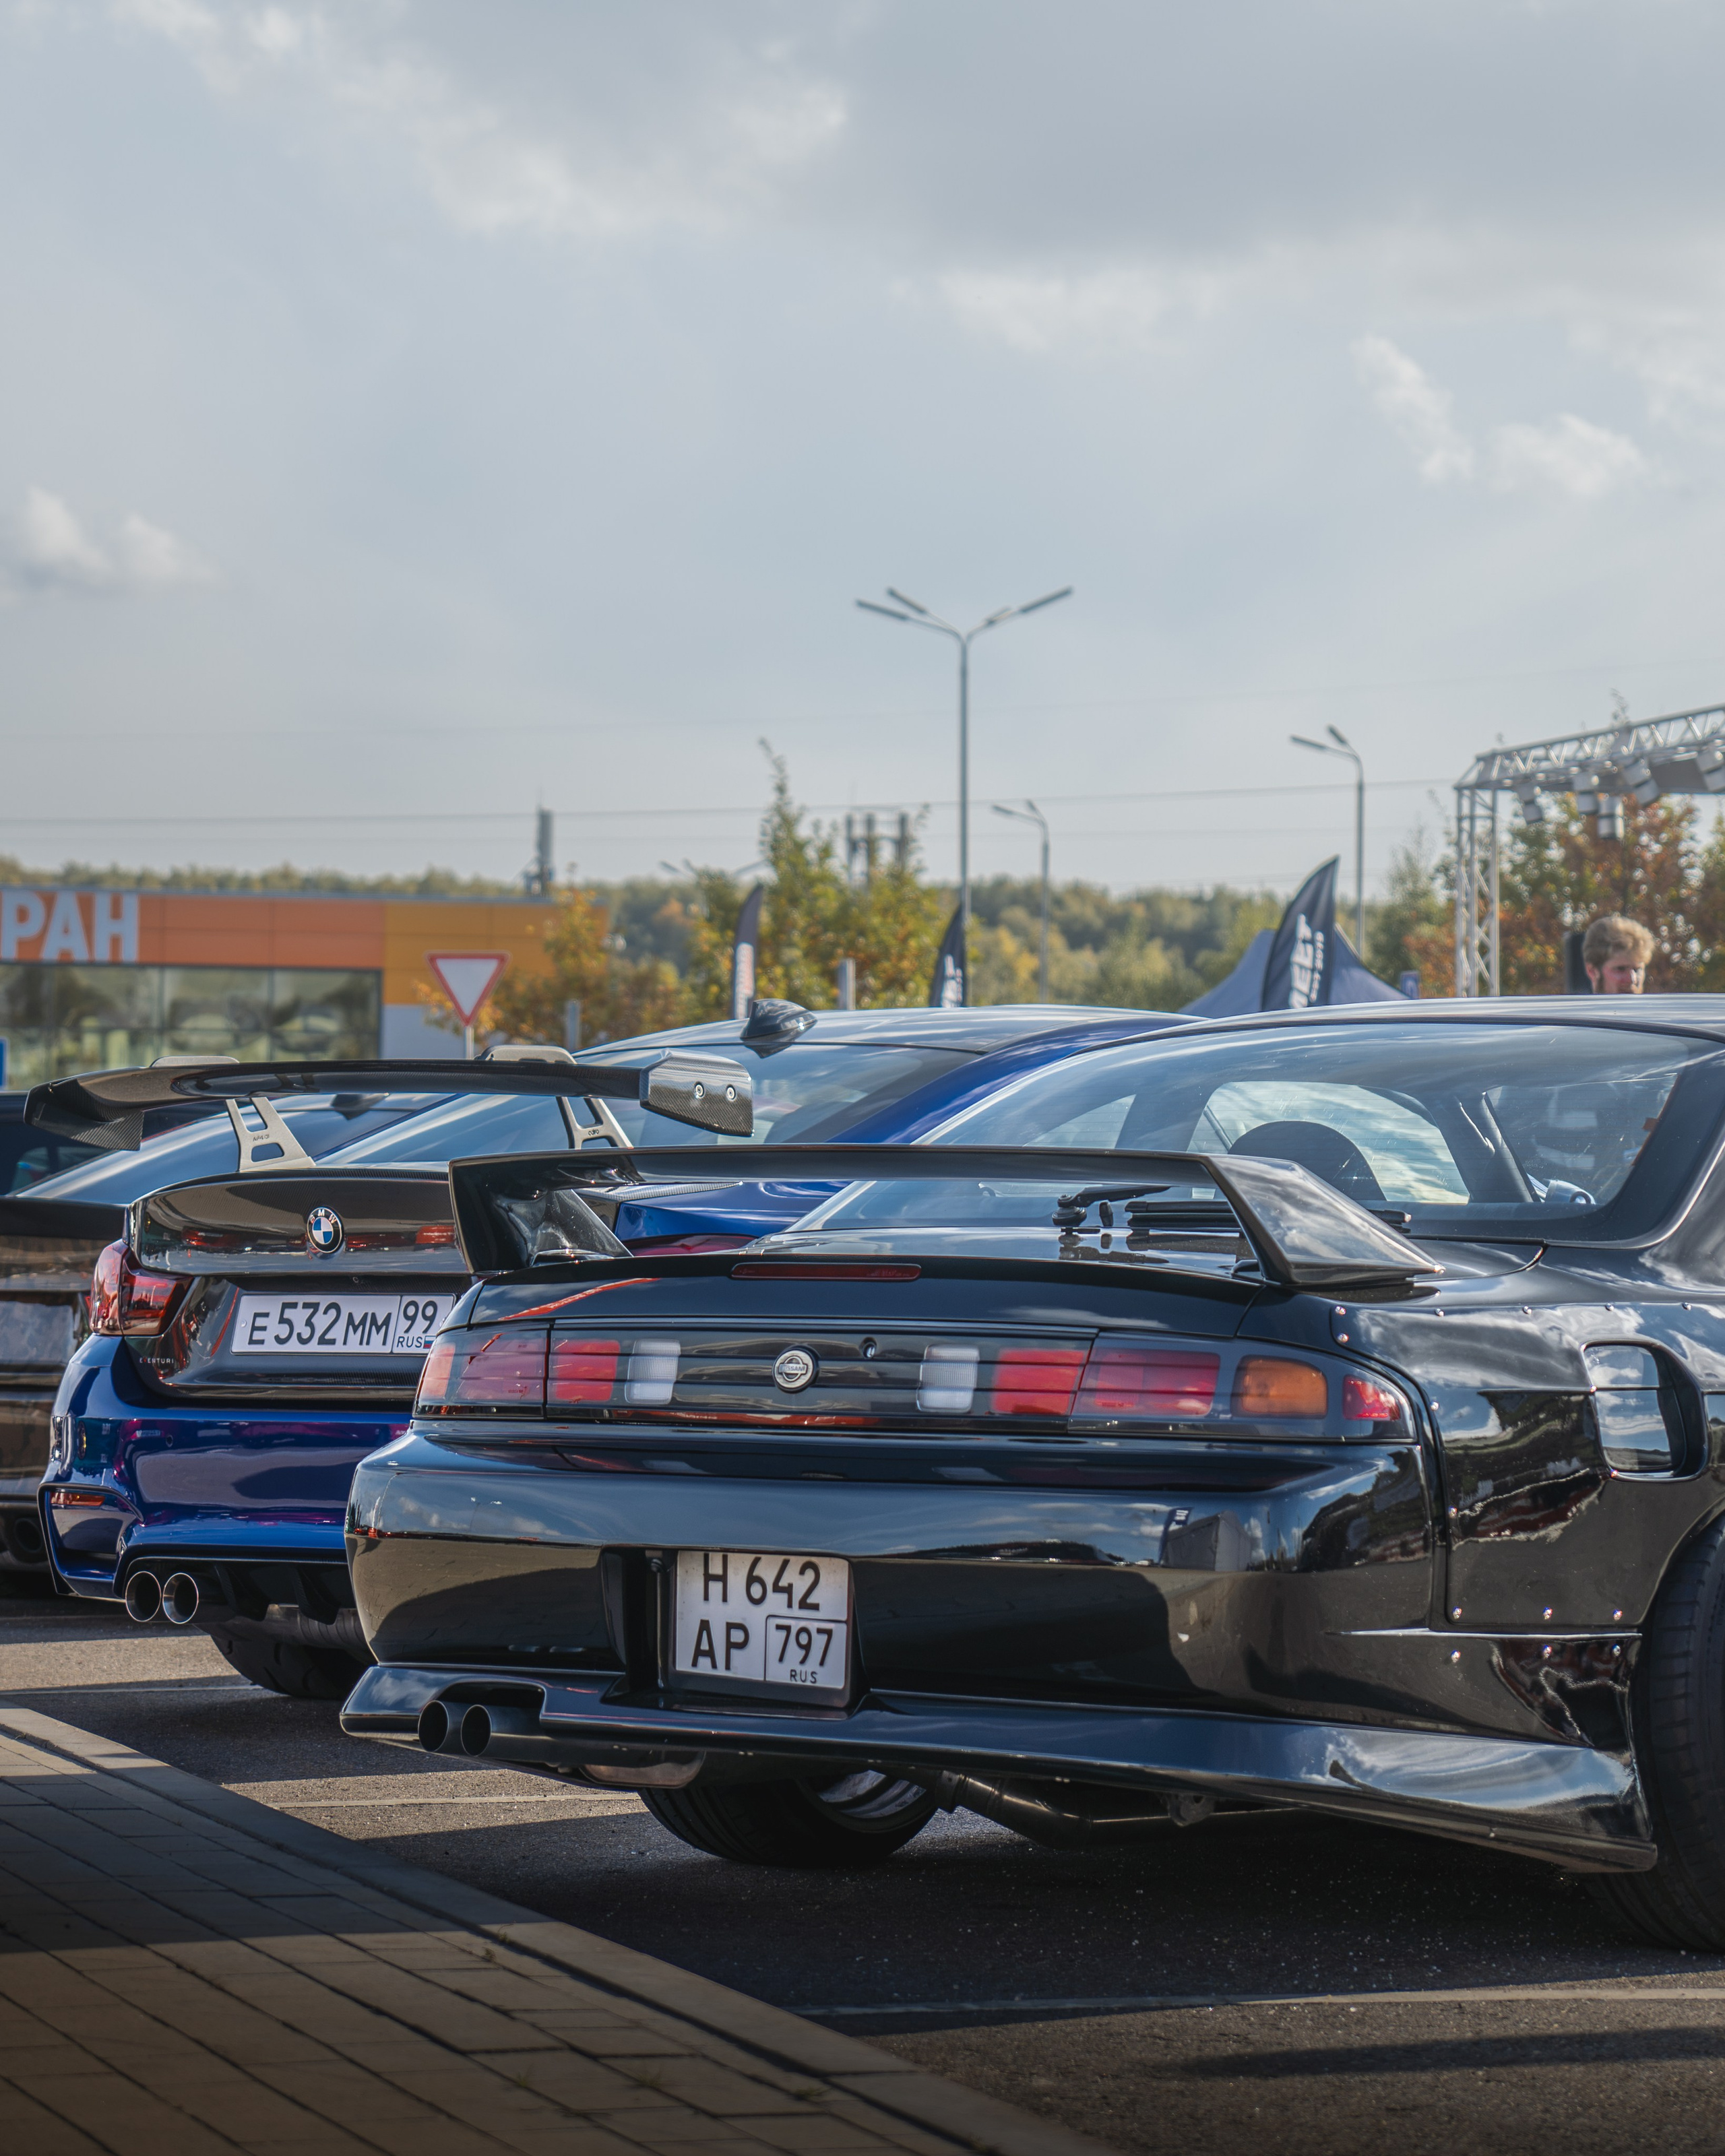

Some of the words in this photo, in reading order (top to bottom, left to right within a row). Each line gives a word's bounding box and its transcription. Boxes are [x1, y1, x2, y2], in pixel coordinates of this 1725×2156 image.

[309, 1209, 338, 1224] BMW
[403, 1300, 438, 1334] 99
[396, 1336, 423, 1348] RUS
[775, 1624, 833, 1666] 797
[790, 1669, 818, 1684] RUS
